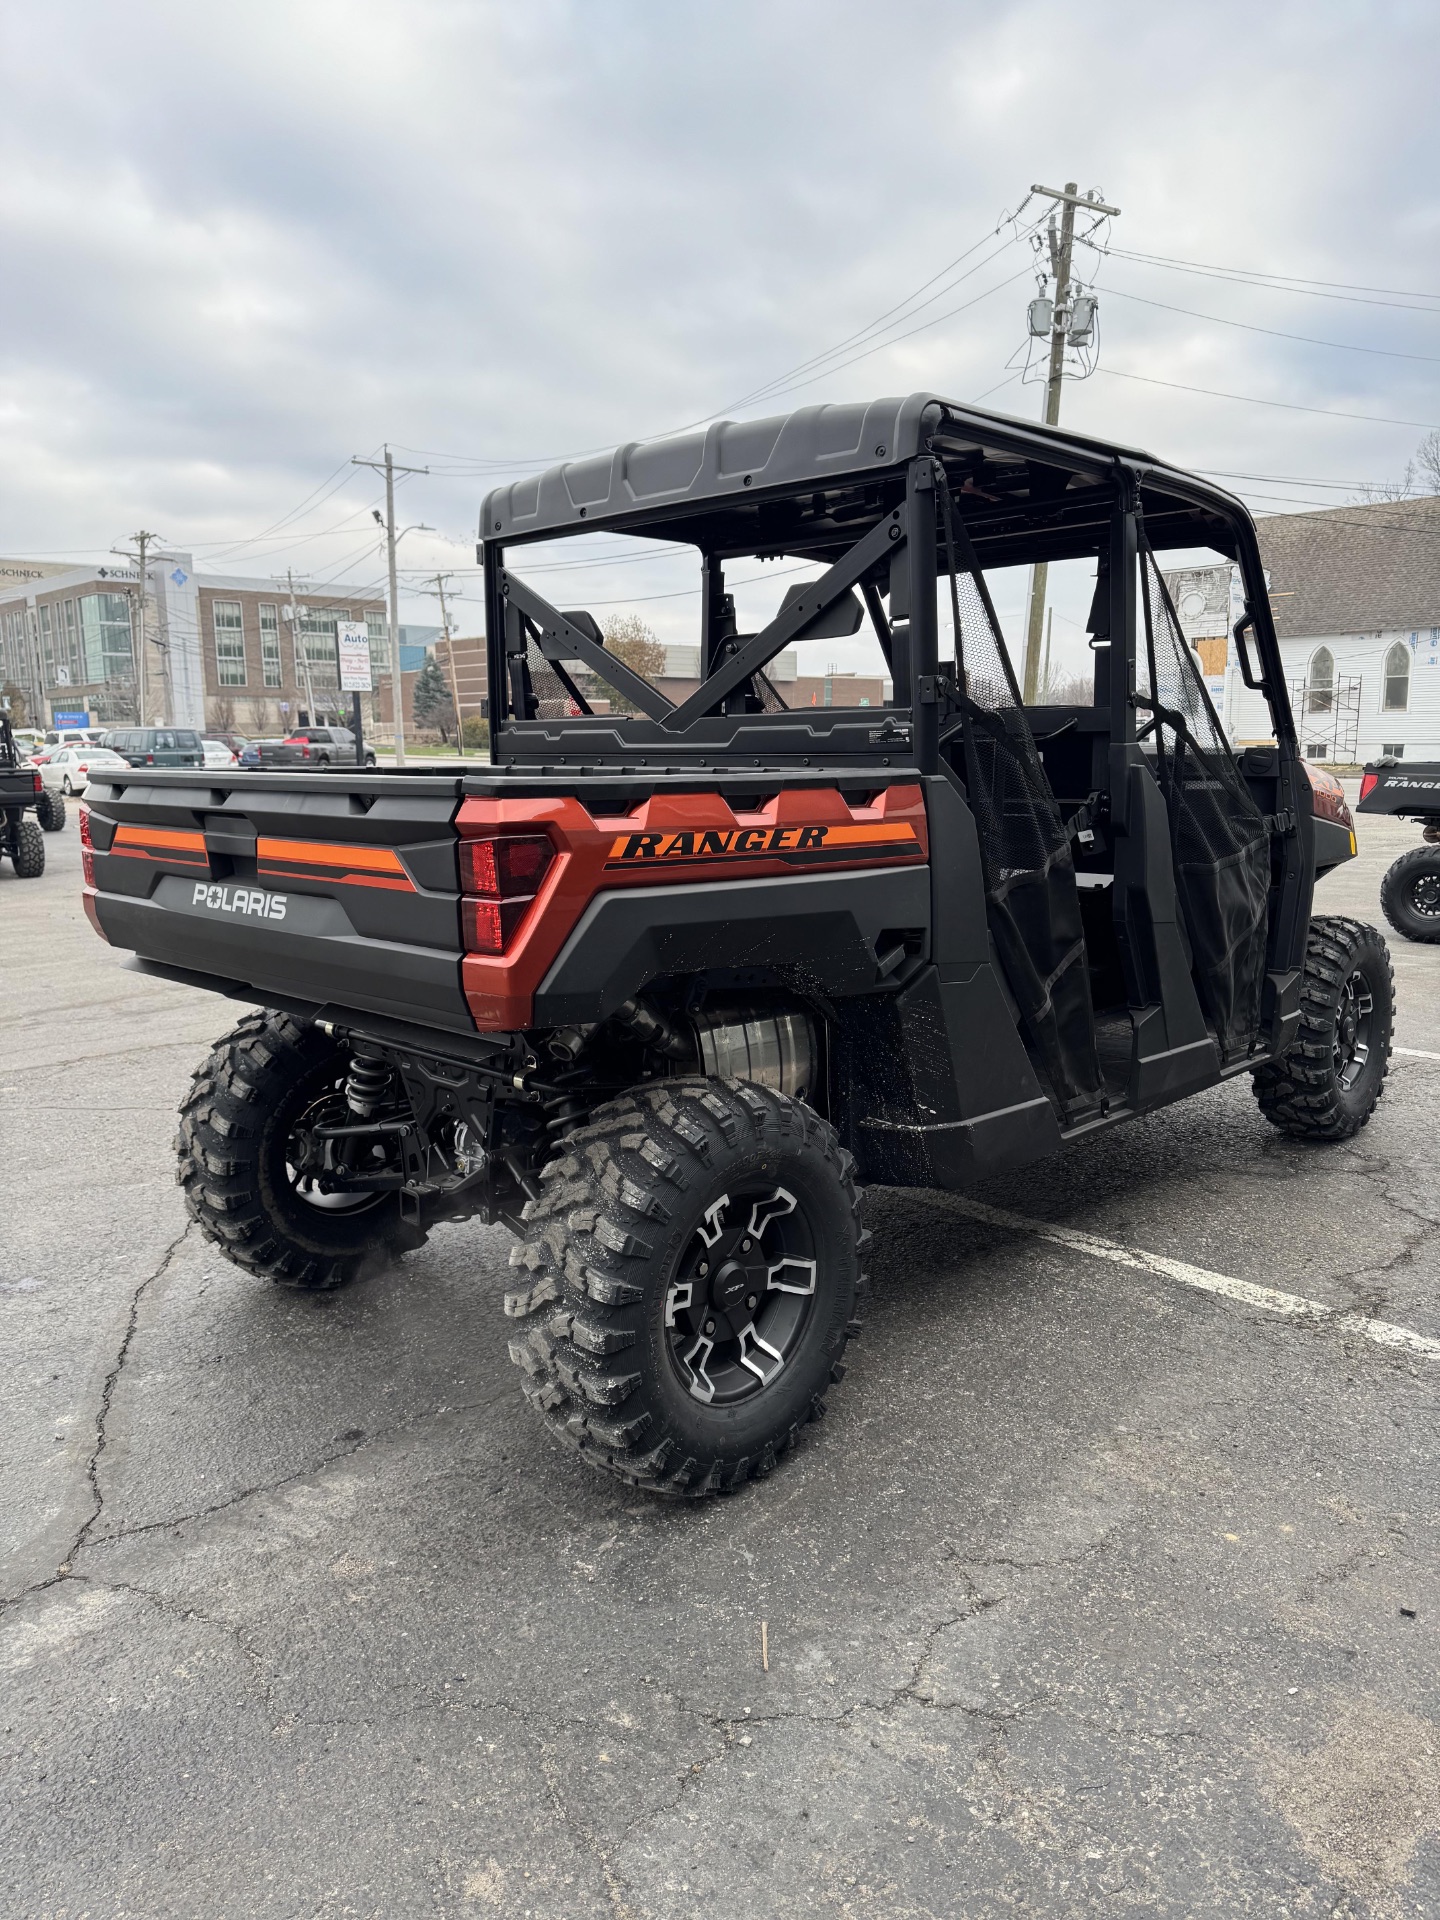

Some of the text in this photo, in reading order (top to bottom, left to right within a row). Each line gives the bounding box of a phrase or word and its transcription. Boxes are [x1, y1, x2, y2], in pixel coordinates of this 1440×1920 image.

[1, 568, 44, 578] SCHNECK
[110, 569, 154, 580] SCHNEK
[344, 633, 368, 643] Auto
[620, 825, 829, 860] RANGER
[192, 883, 288, 920] POLARIS
[725, 1283, 745, 1294] XP
